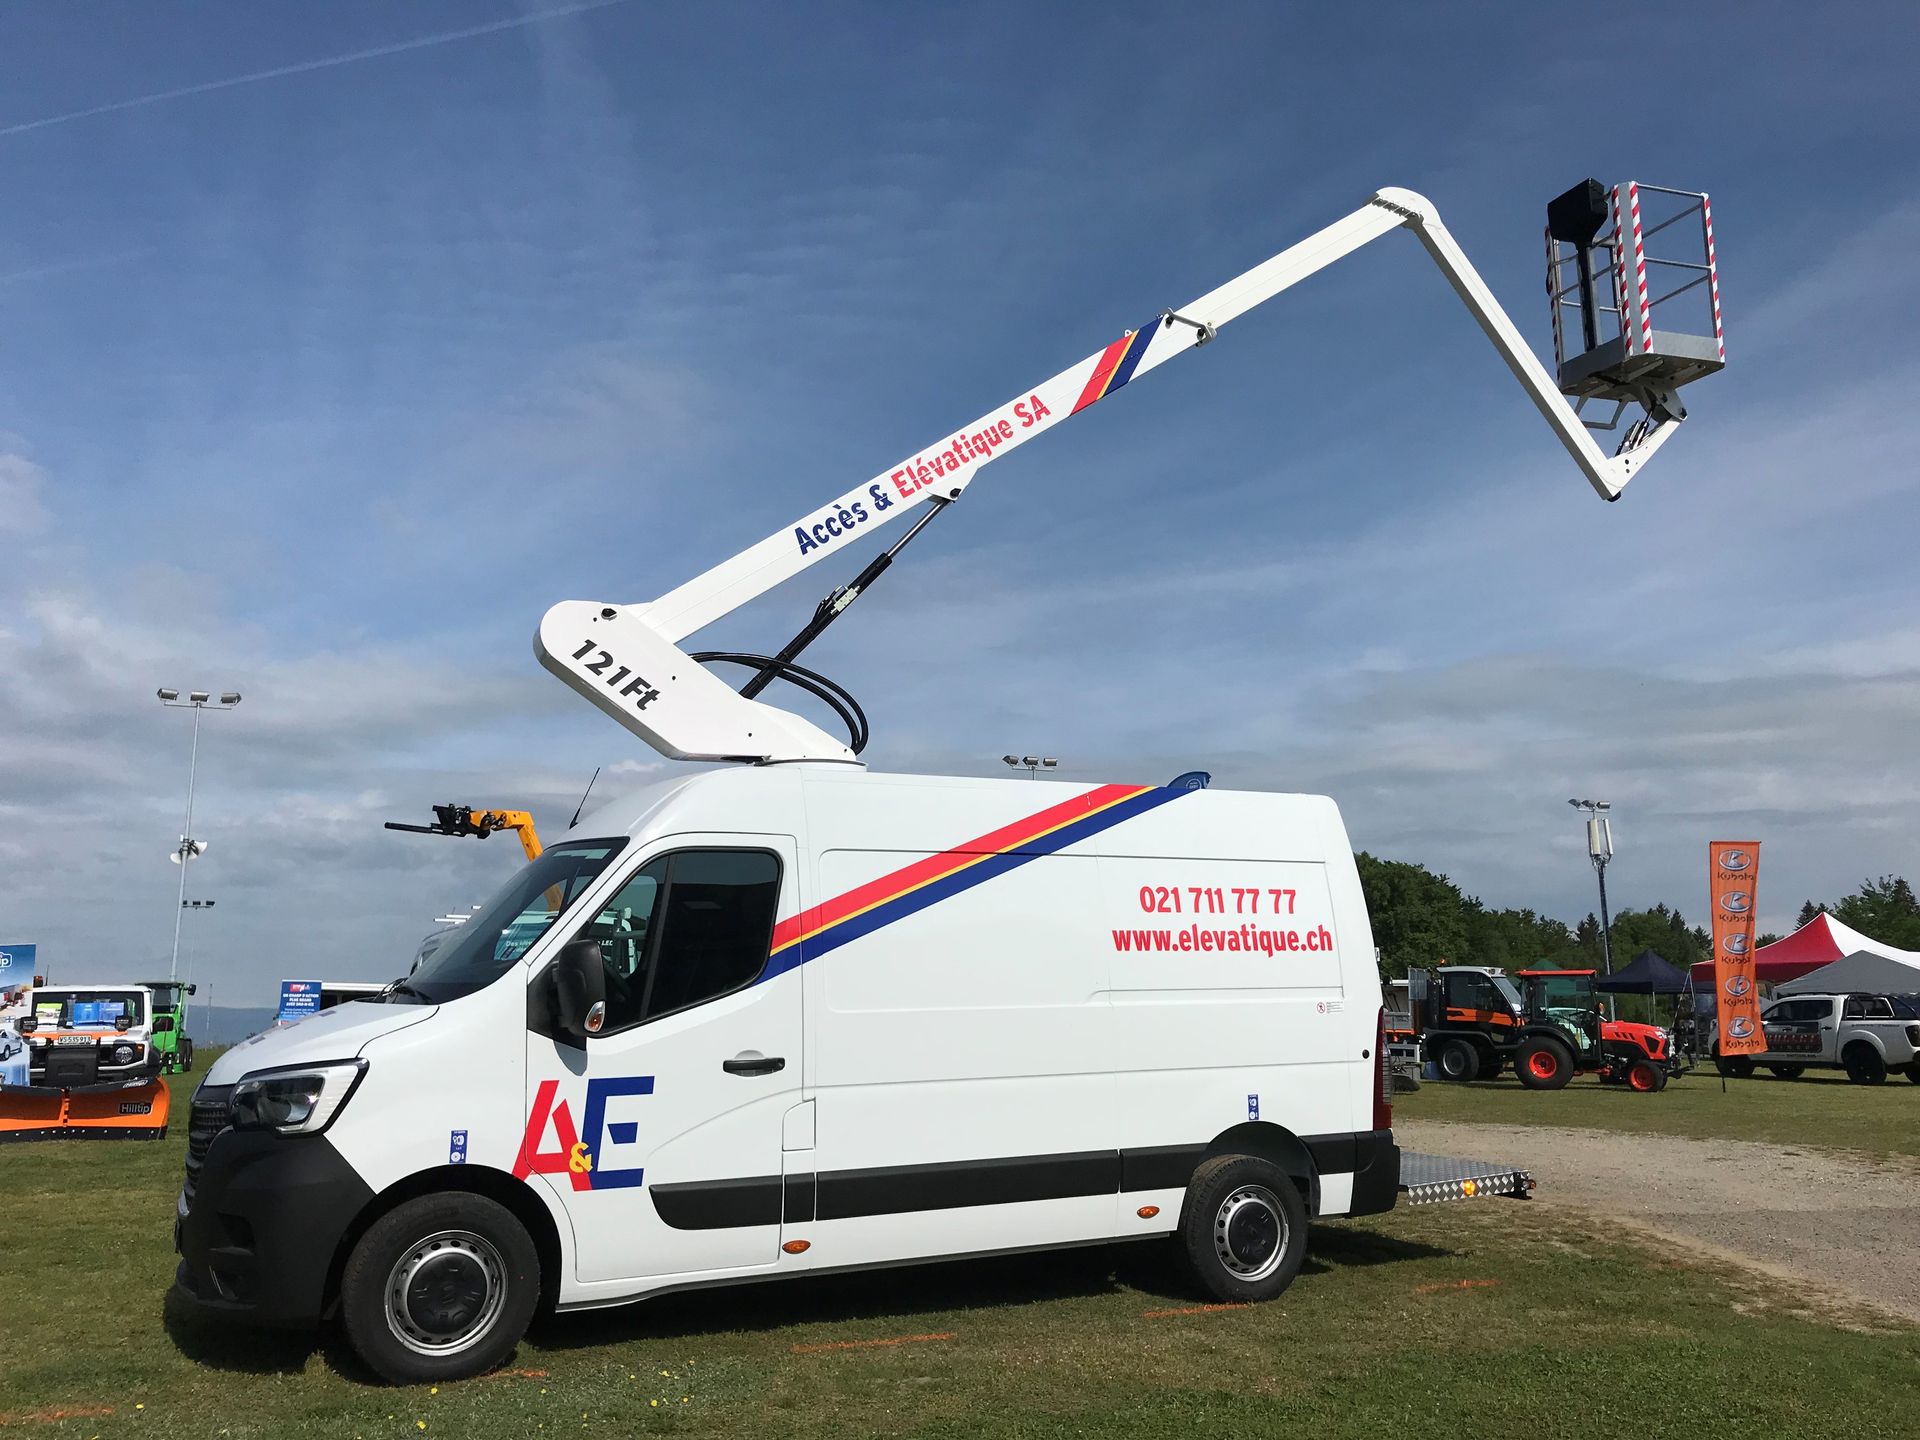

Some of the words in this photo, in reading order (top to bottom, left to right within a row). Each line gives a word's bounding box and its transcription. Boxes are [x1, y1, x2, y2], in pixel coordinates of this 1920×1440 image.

[794, 504, 869, 556] Accès
[869, 484, 894, 511] &
[890, 419, 1014, 499] Elévatique
[1013, 394, 1051, 428] SA
[571, 639, 661, 711] 121Ft
[1717, 871, 1755, 881] Kubota
[1139, 886, 1182, 913] 021
[1188, 887, 1225, 913] 711
[1231, 888, 1260, 914] 77
[1267, 889, 1297, 914] 77
[1719, 914, 1755, 923] Kubota
[1112, 923, 1333, 958] www.elevatique.ch
[1725, 1040, 1760, 1049] Kubota
[121, 1103, 150, 1114] Hilltip
